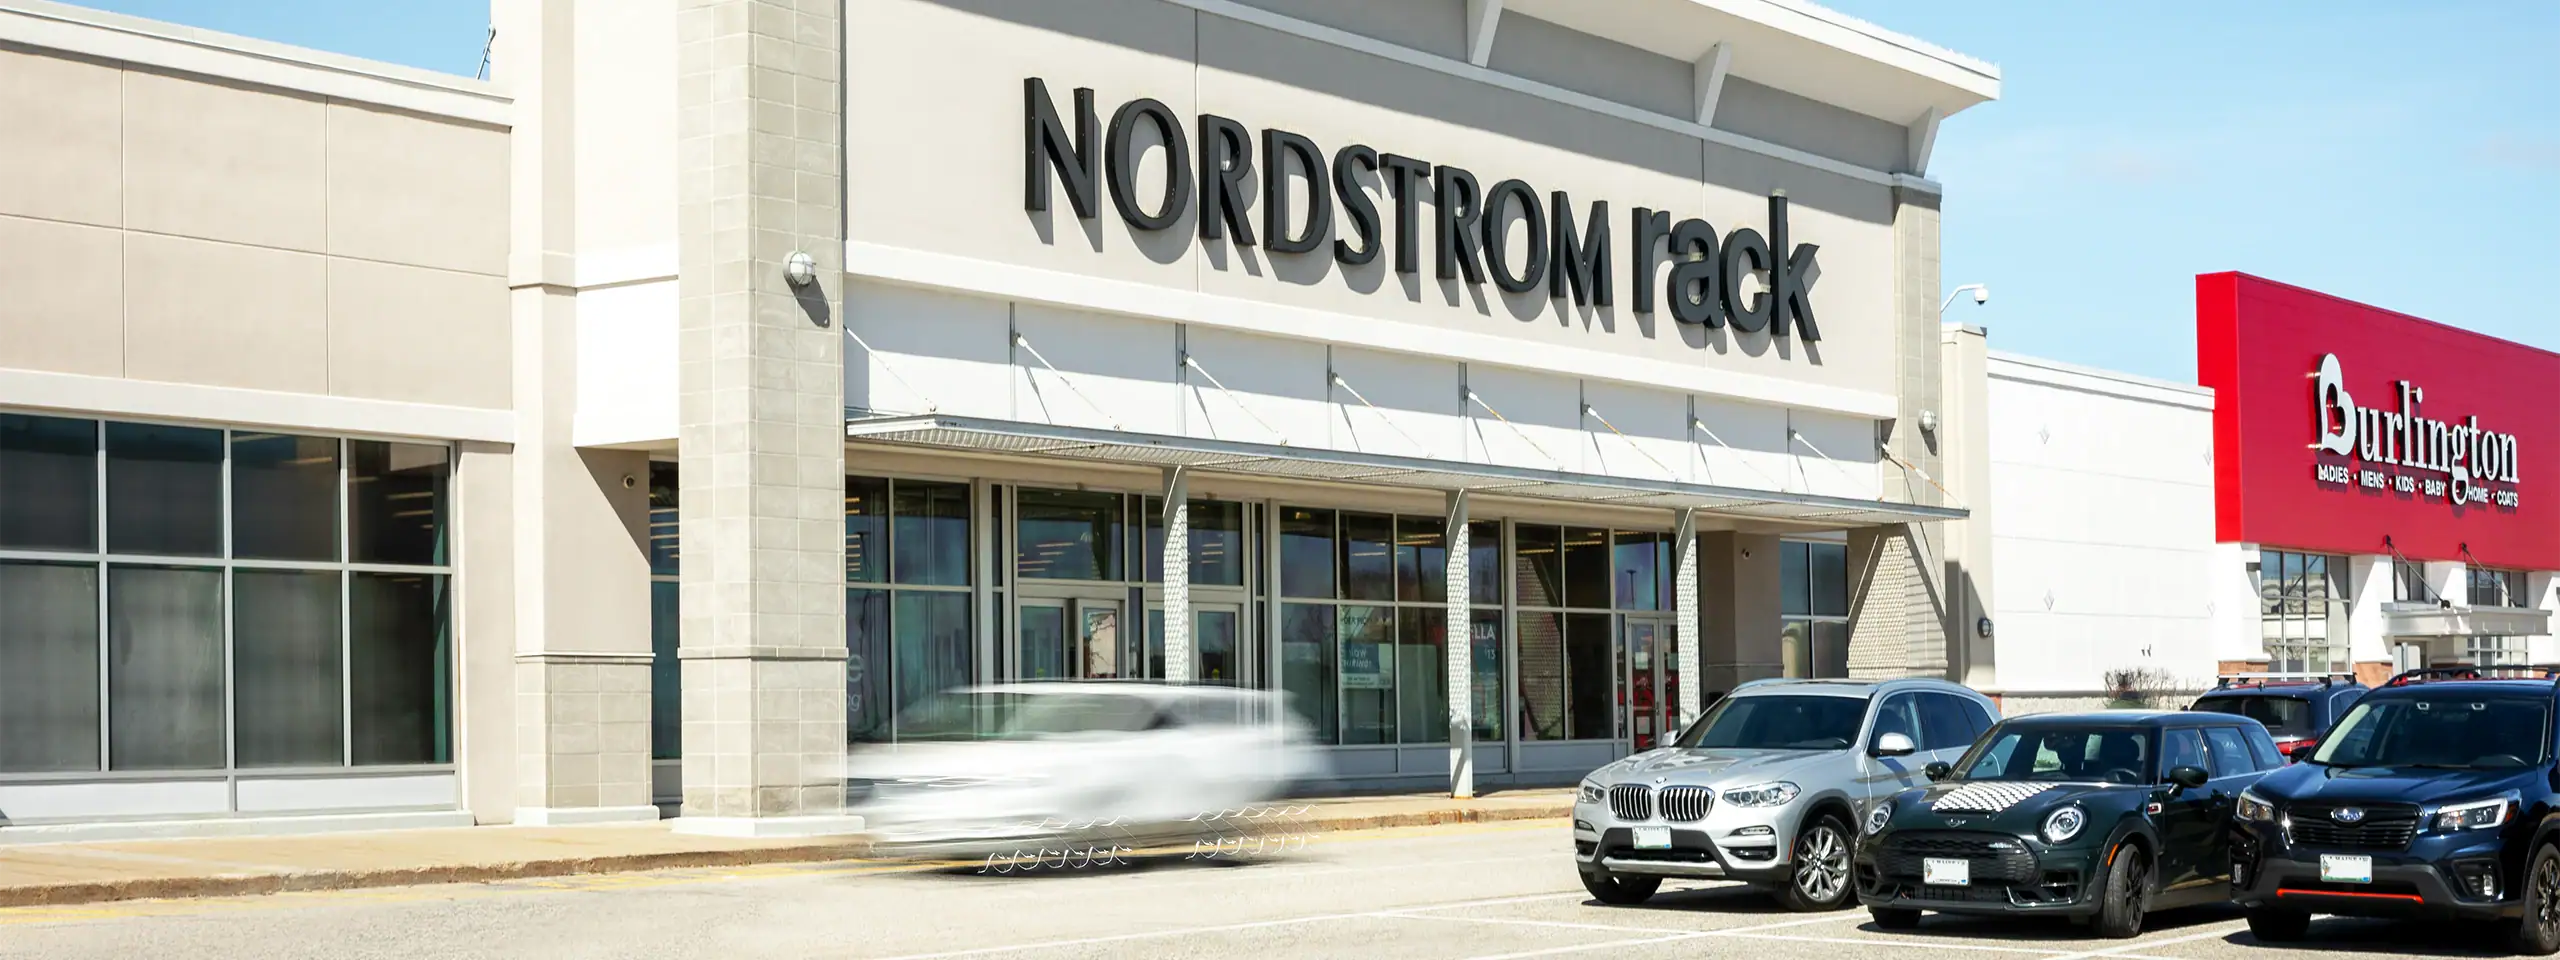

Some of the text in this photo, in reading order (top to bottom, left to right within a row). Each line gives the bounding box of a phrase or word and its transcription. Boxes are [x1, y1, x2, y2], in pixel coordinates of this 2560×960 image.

[1024, 77, 1823, 343] NORDSTROM rack
[2317, 353, 2520, 505] Burlington
[2317, 463, 2519, 508] LADIES MENS KIDS BABY HOME COATS
